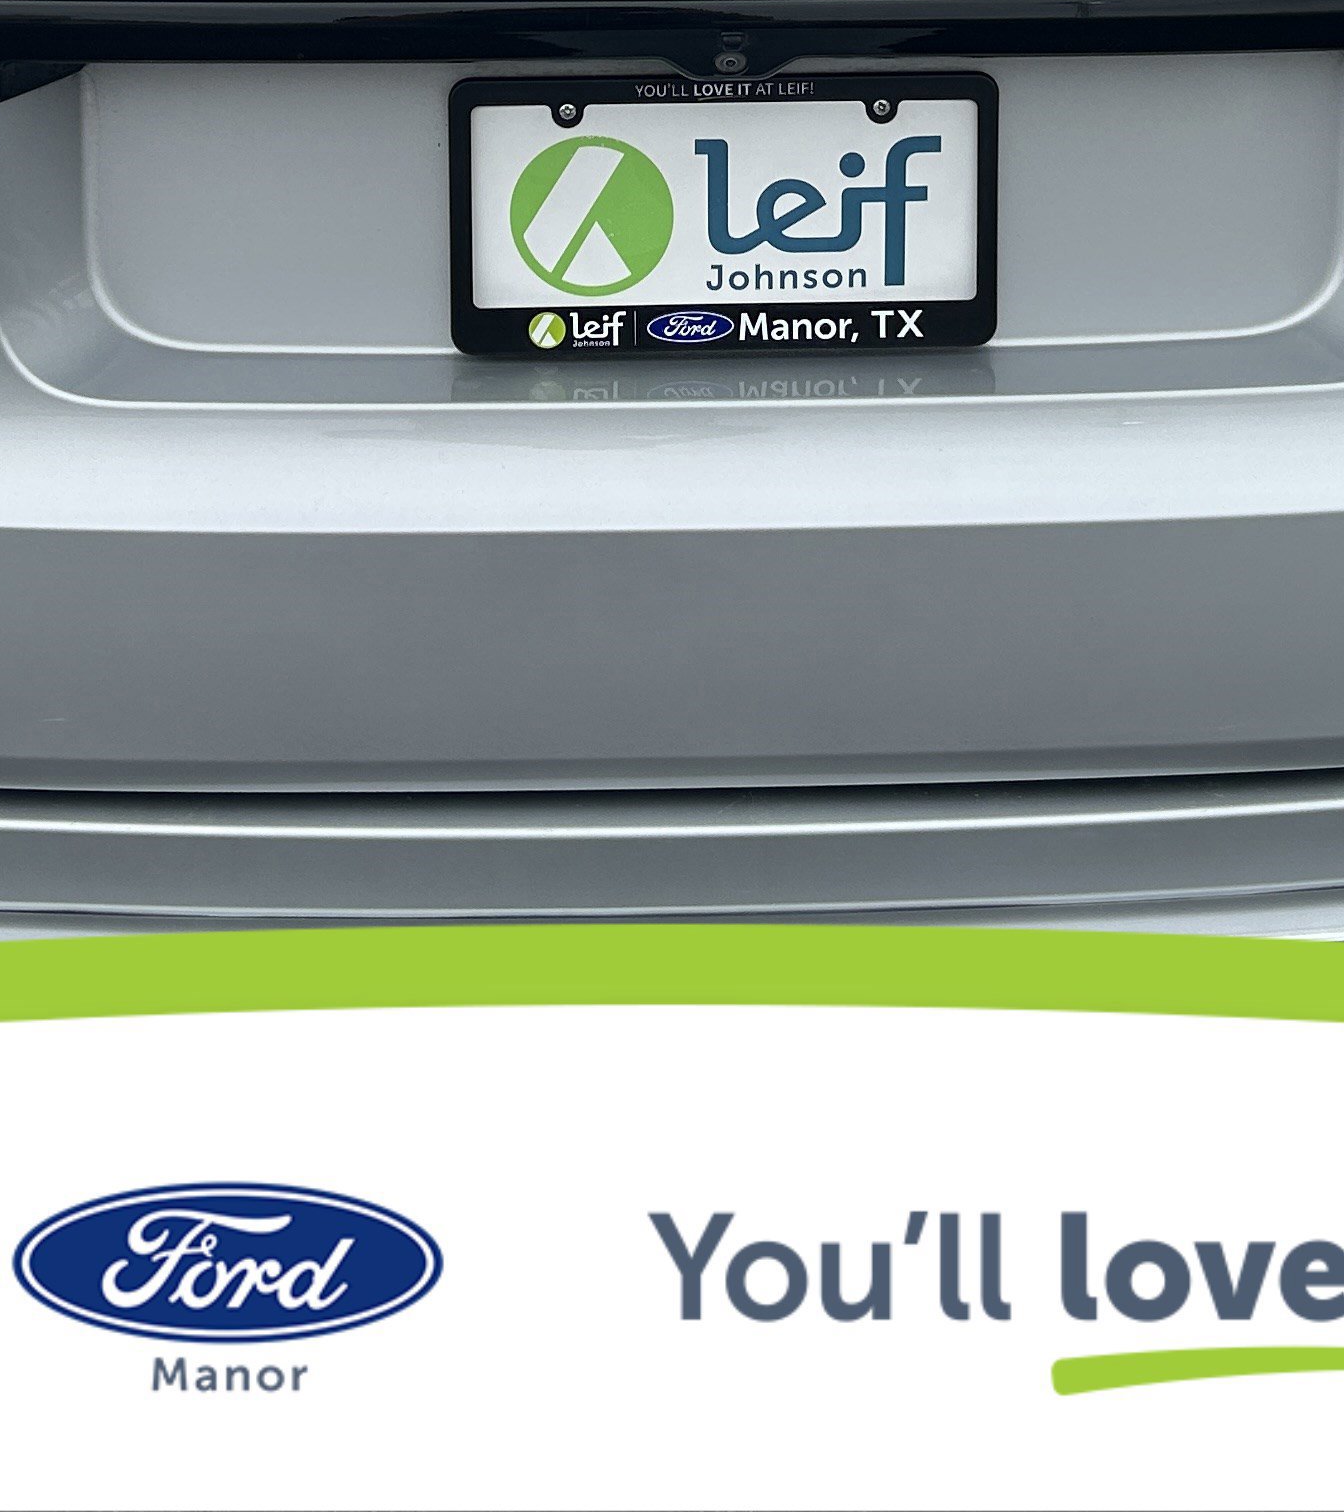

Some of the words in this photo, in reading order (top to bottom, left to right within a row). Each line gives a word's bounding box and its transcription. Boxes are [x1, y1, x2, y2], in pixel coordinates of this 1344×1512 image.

[635, 83, 689, 98] YOU'LL
[693, 82, 733, 96] LOVE
[737, 82, 752, 96] IT
[755, 82, 774, 96] AT
[778, 81, 816, 96] LEIF!
[694, 135, 942, 290] leif
[706, 263, 867, 292] Johnson
[569, 310, 626, 346] leif
[663, 315, 716, 337] Ford
[739, 312, 859, 343] Manor,
[871, 309, 924, 339] TX
